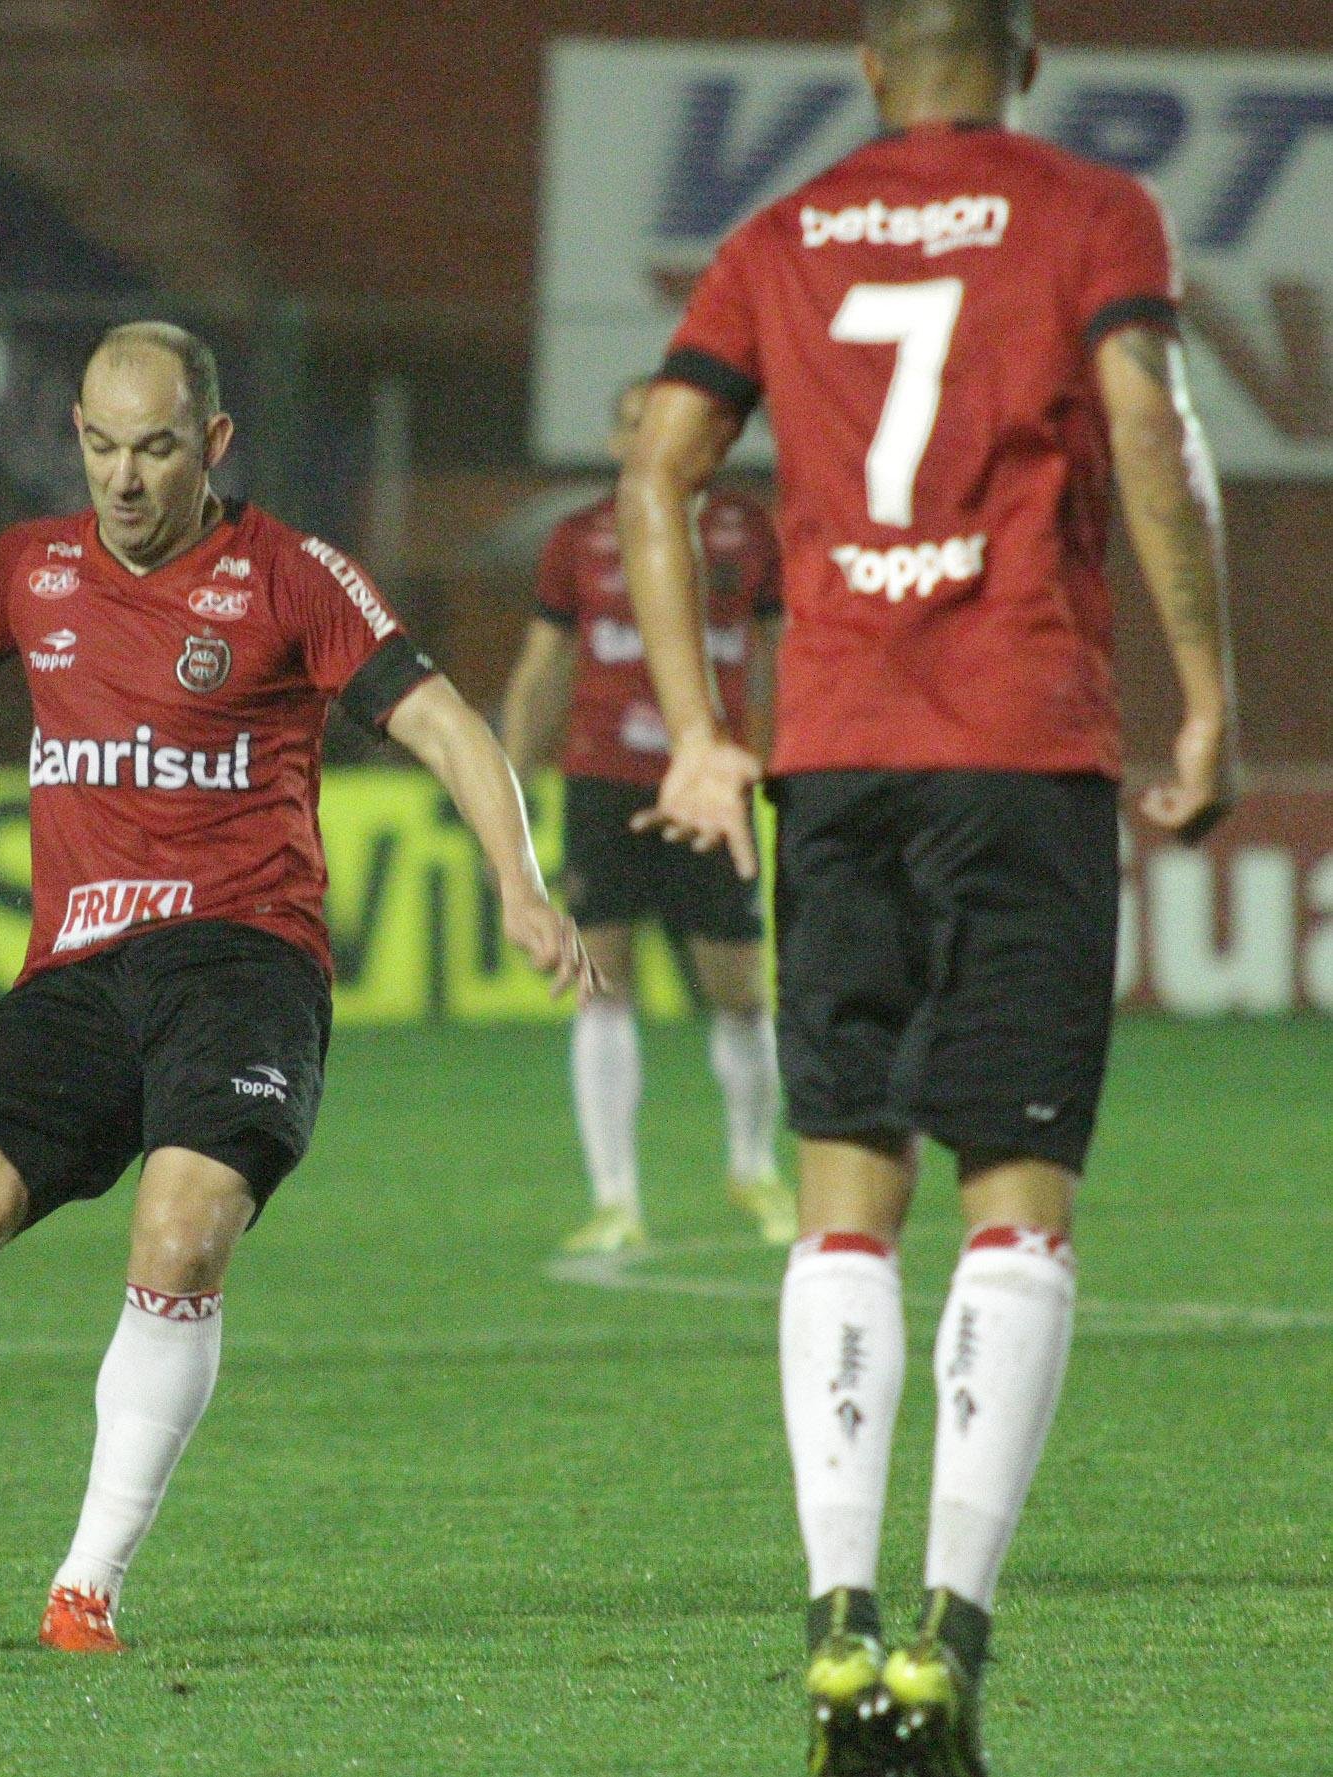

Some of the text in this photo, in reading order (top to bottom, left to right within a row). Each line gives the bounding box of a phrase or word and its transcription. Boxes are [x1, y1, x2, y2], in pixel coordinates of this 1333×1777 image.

[828, 277, 964, 528] 7
[830, 530, 987, 604] Topper
[29, 651, 75, 672] Topper
